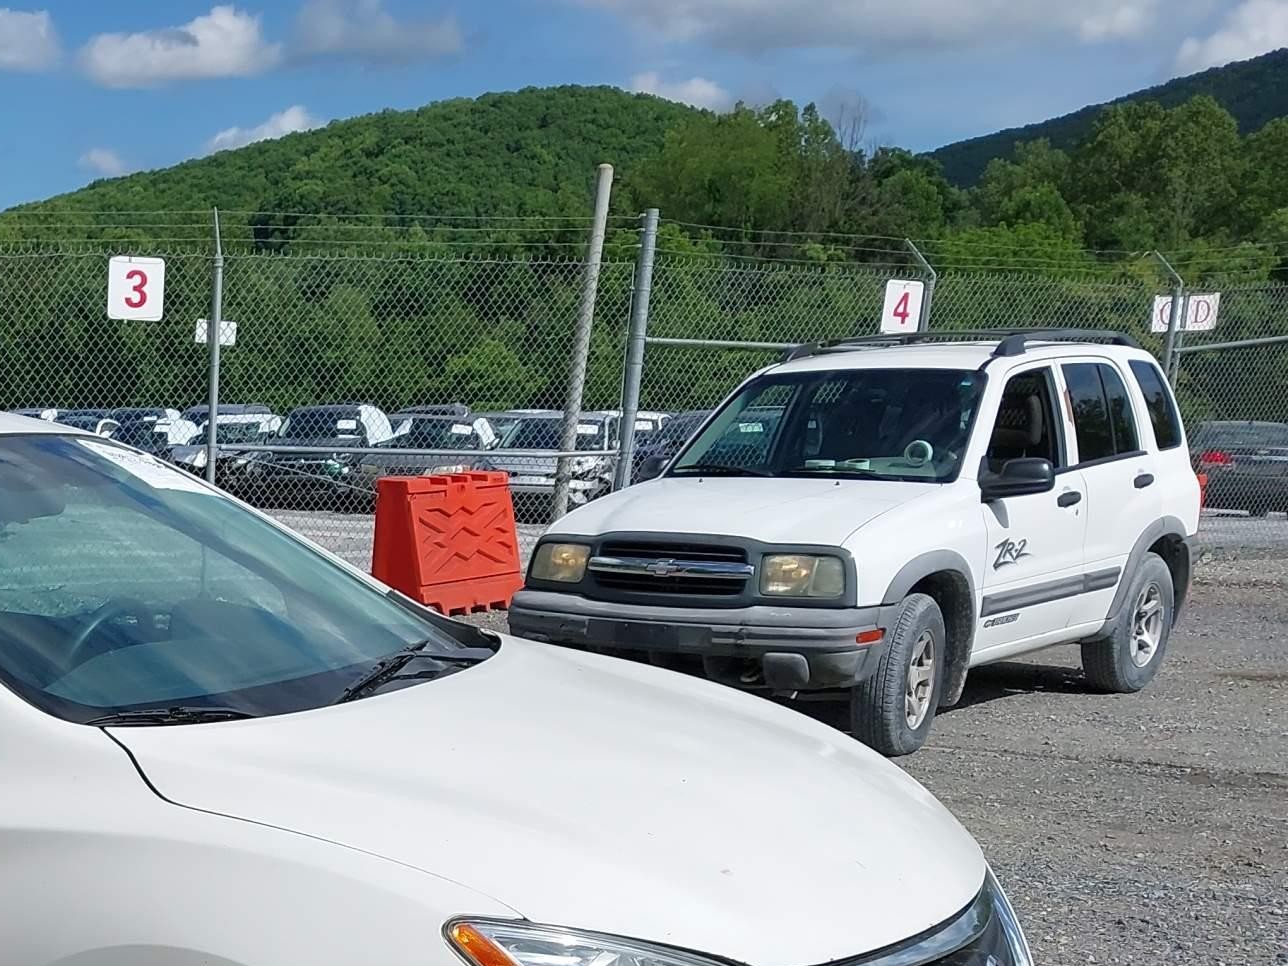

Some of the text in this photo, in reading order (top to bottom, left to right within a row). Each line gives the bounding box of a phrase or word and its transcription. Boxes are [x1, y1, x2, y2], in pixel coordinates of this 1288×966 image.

[124, 269, 148, 309] 3
[892, 291, 910, 325] 4
[1191, 299, 1211, 325] D
